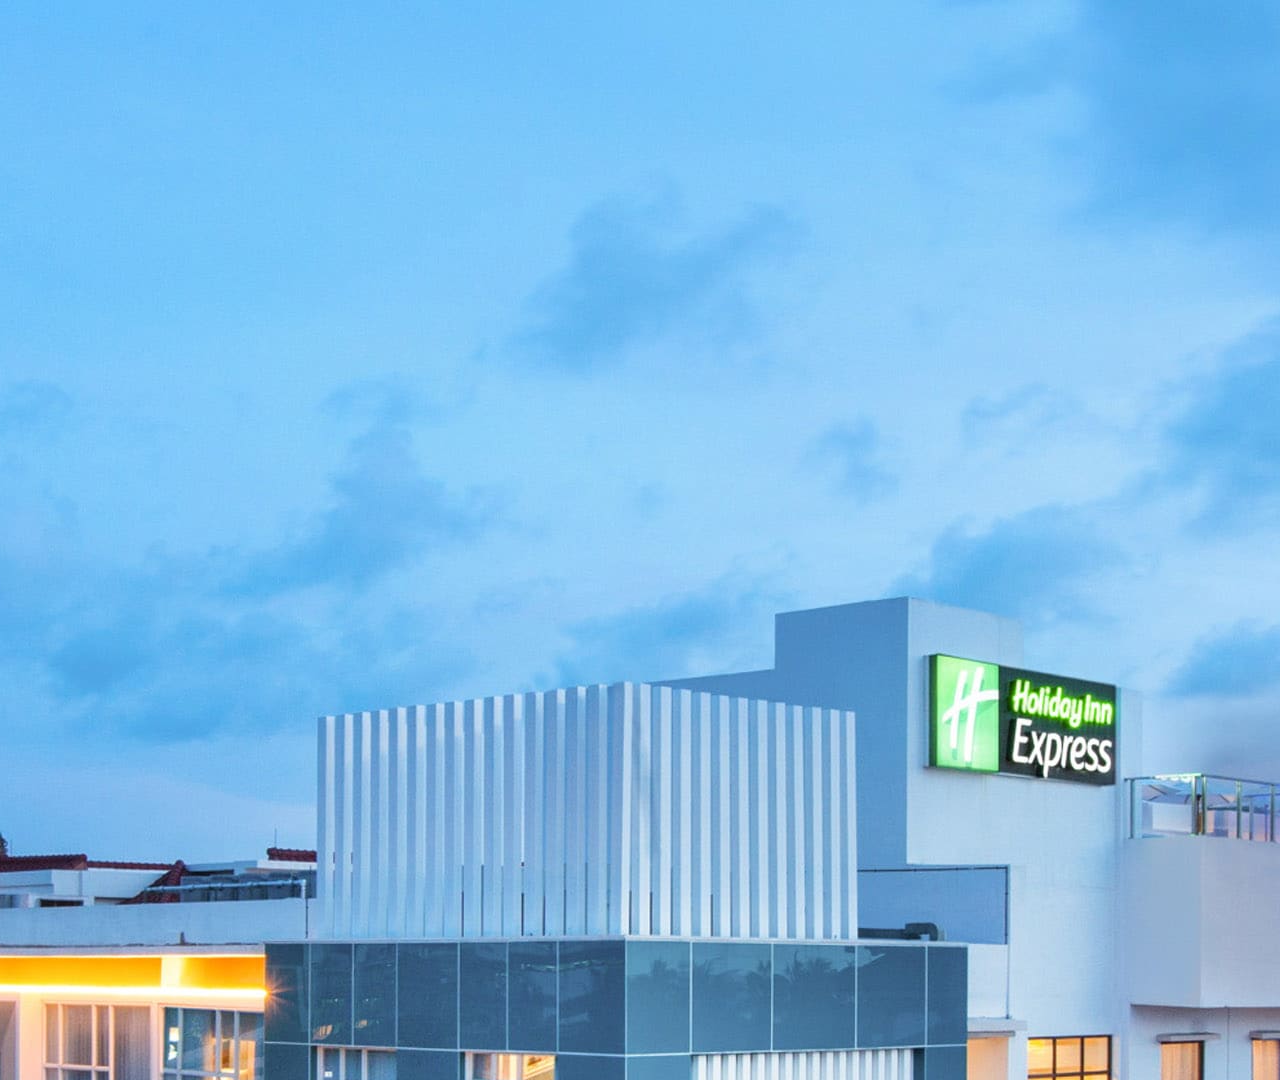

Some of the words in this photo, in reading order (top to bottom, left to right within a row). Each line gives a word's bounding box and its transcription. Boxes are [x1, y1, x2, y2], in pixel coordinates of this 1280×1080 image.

[1013, 679, 1084, 728] Holiday
[1084, 694, 1113, 725] Inn
[1012, 717, 1113, 779] Express
